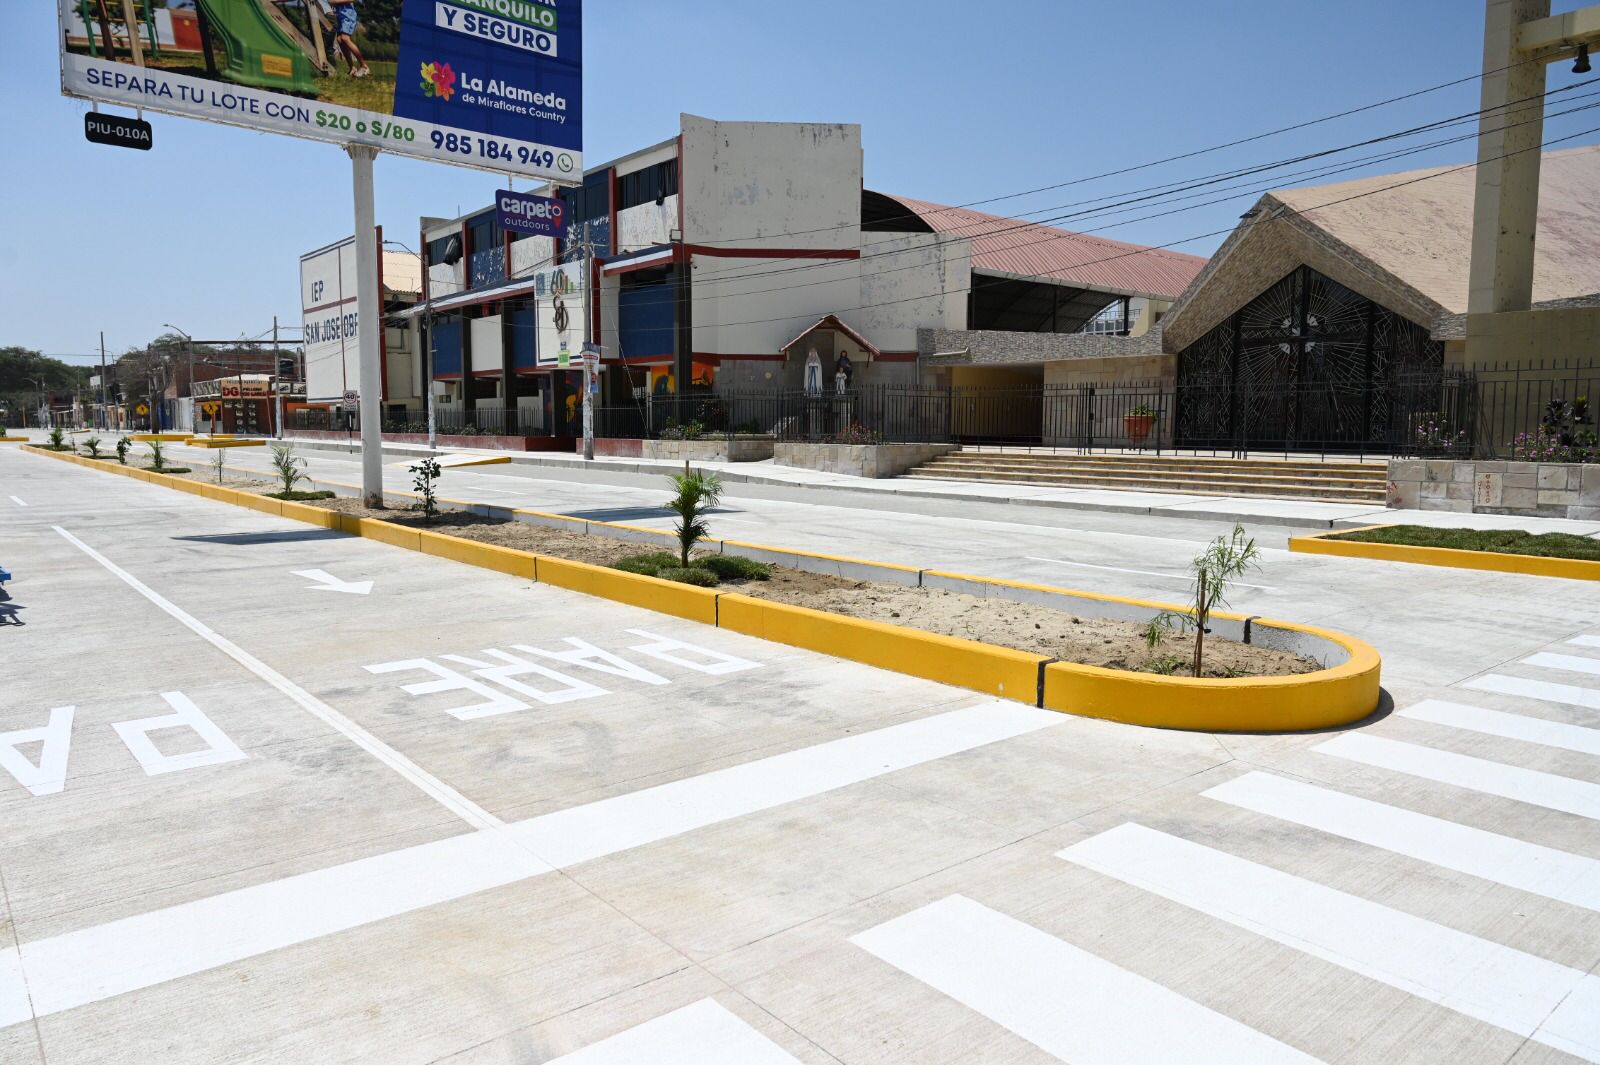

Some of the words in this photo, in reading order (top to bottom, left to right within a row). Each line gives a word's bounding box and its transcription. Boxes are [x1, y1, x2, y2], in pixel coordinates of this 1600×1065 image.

[442, 6, 457, 26] Y
[464, 13, 551, 52] SEGURO
[86, 68, 173, 99] SEPARA
[177, 85, 204, 103] TU
[211, 91, 260, 114] LOTE
[265, 102, 310, 123] CON
[315, 109, 351, 131] $20
[371, 119, 415, 142] S/80
[461, 72, 483, 92] La
[486, 79, 566, 111] Alameda
[462, 93, 476, 104] de
[478, 95, 527, 114] Miraflores
[529, 107, 566, 124] Country
[87, 121, 150, 142] PIU-010A
[430, 130, 472, 155] 985
[477, 138, 513, 162] 184
[517, 145, 554, 169] 949
[504, 217, 550, 231] outdoors
[311, 280, 324, 303] IEP
[305, 321, 320, 345] SAN
[321, 317, 340, 342] JOSE
[362, 628, 766, 722] PARE
